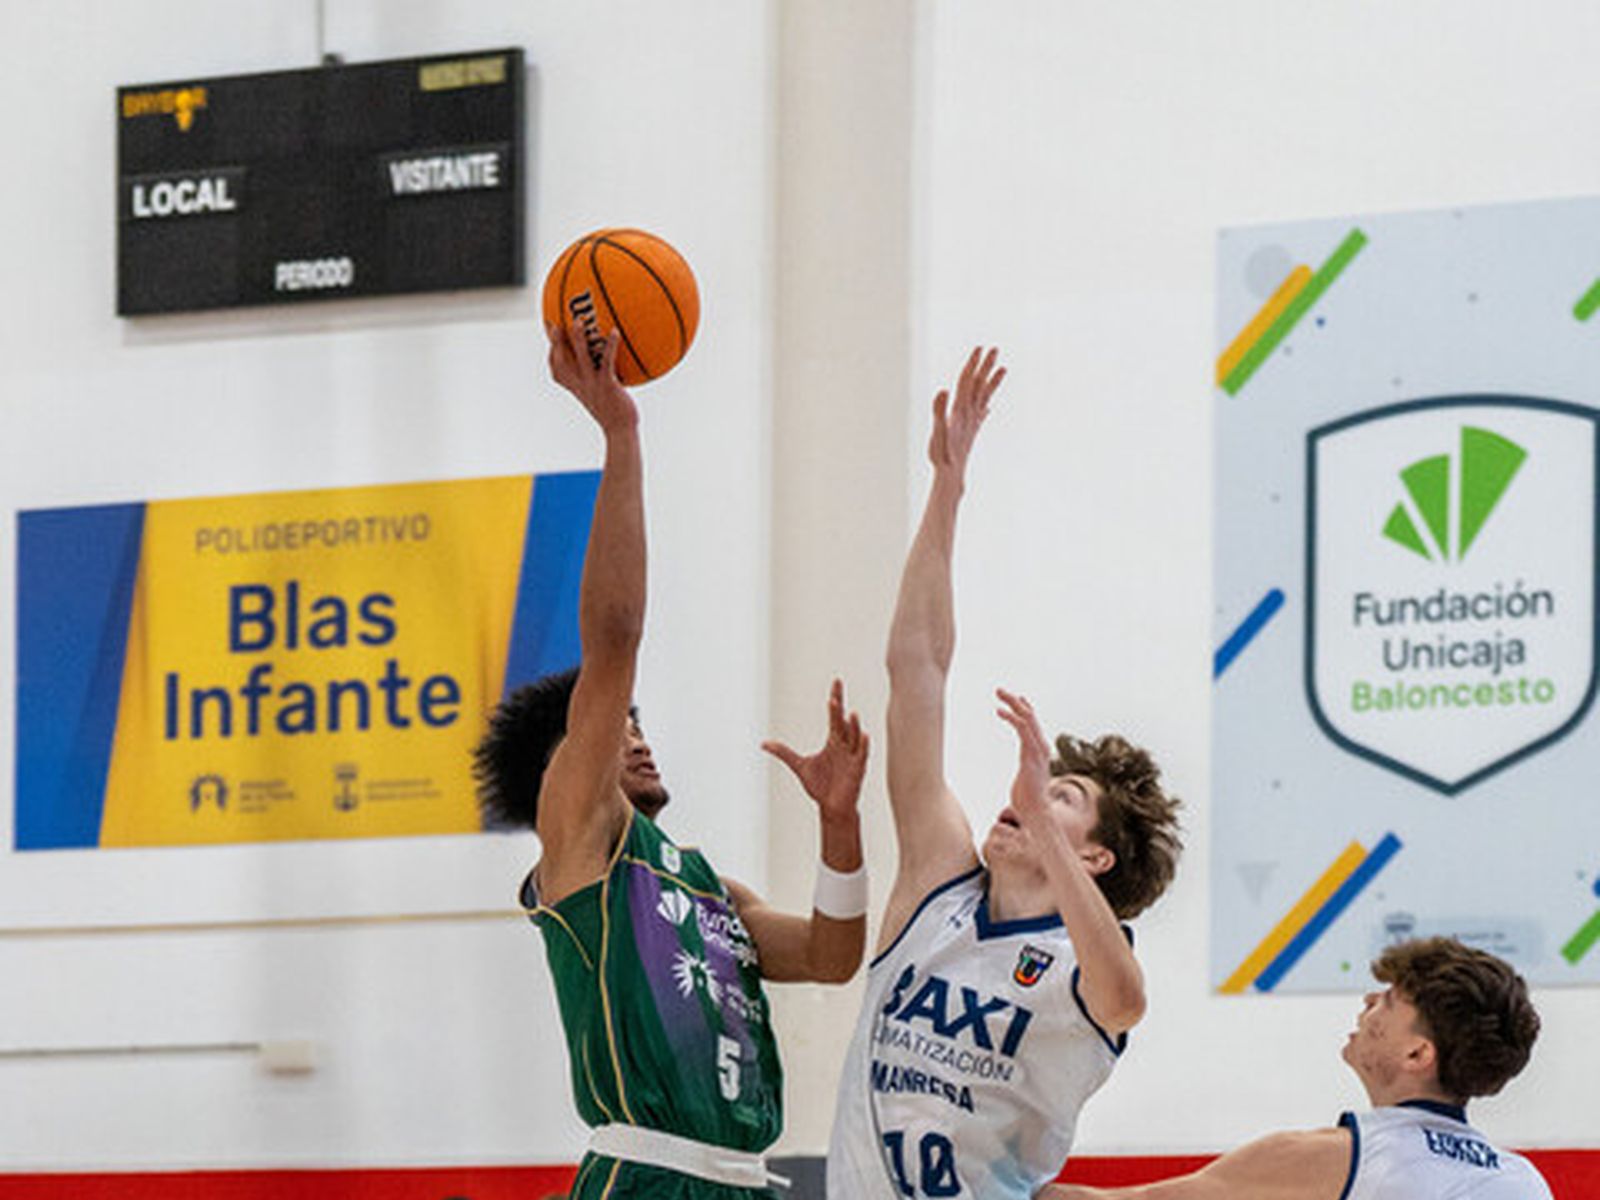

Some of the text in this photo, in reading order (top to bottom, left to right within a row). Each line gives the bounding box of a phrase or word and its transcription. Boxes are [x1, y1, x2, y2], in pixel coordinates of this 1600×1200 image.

[389, 152, 499, 195] VISITANTE
[132, 178, 236, 217] LOCAL
[194, 513, 432, 552] POLIDEPORTIVO
[228, 579, 397, 654] Blas
[1353, 579, 1555, 626] Fundación
[1382, 631, 1525, 675] Unicaja
[165, 658, 462, 741] Infante
[1351, 677, 1555, 712] Baloncesto
[717, 1034, 742, 1101] 5
[882, 1130, 962, 1198] 10
